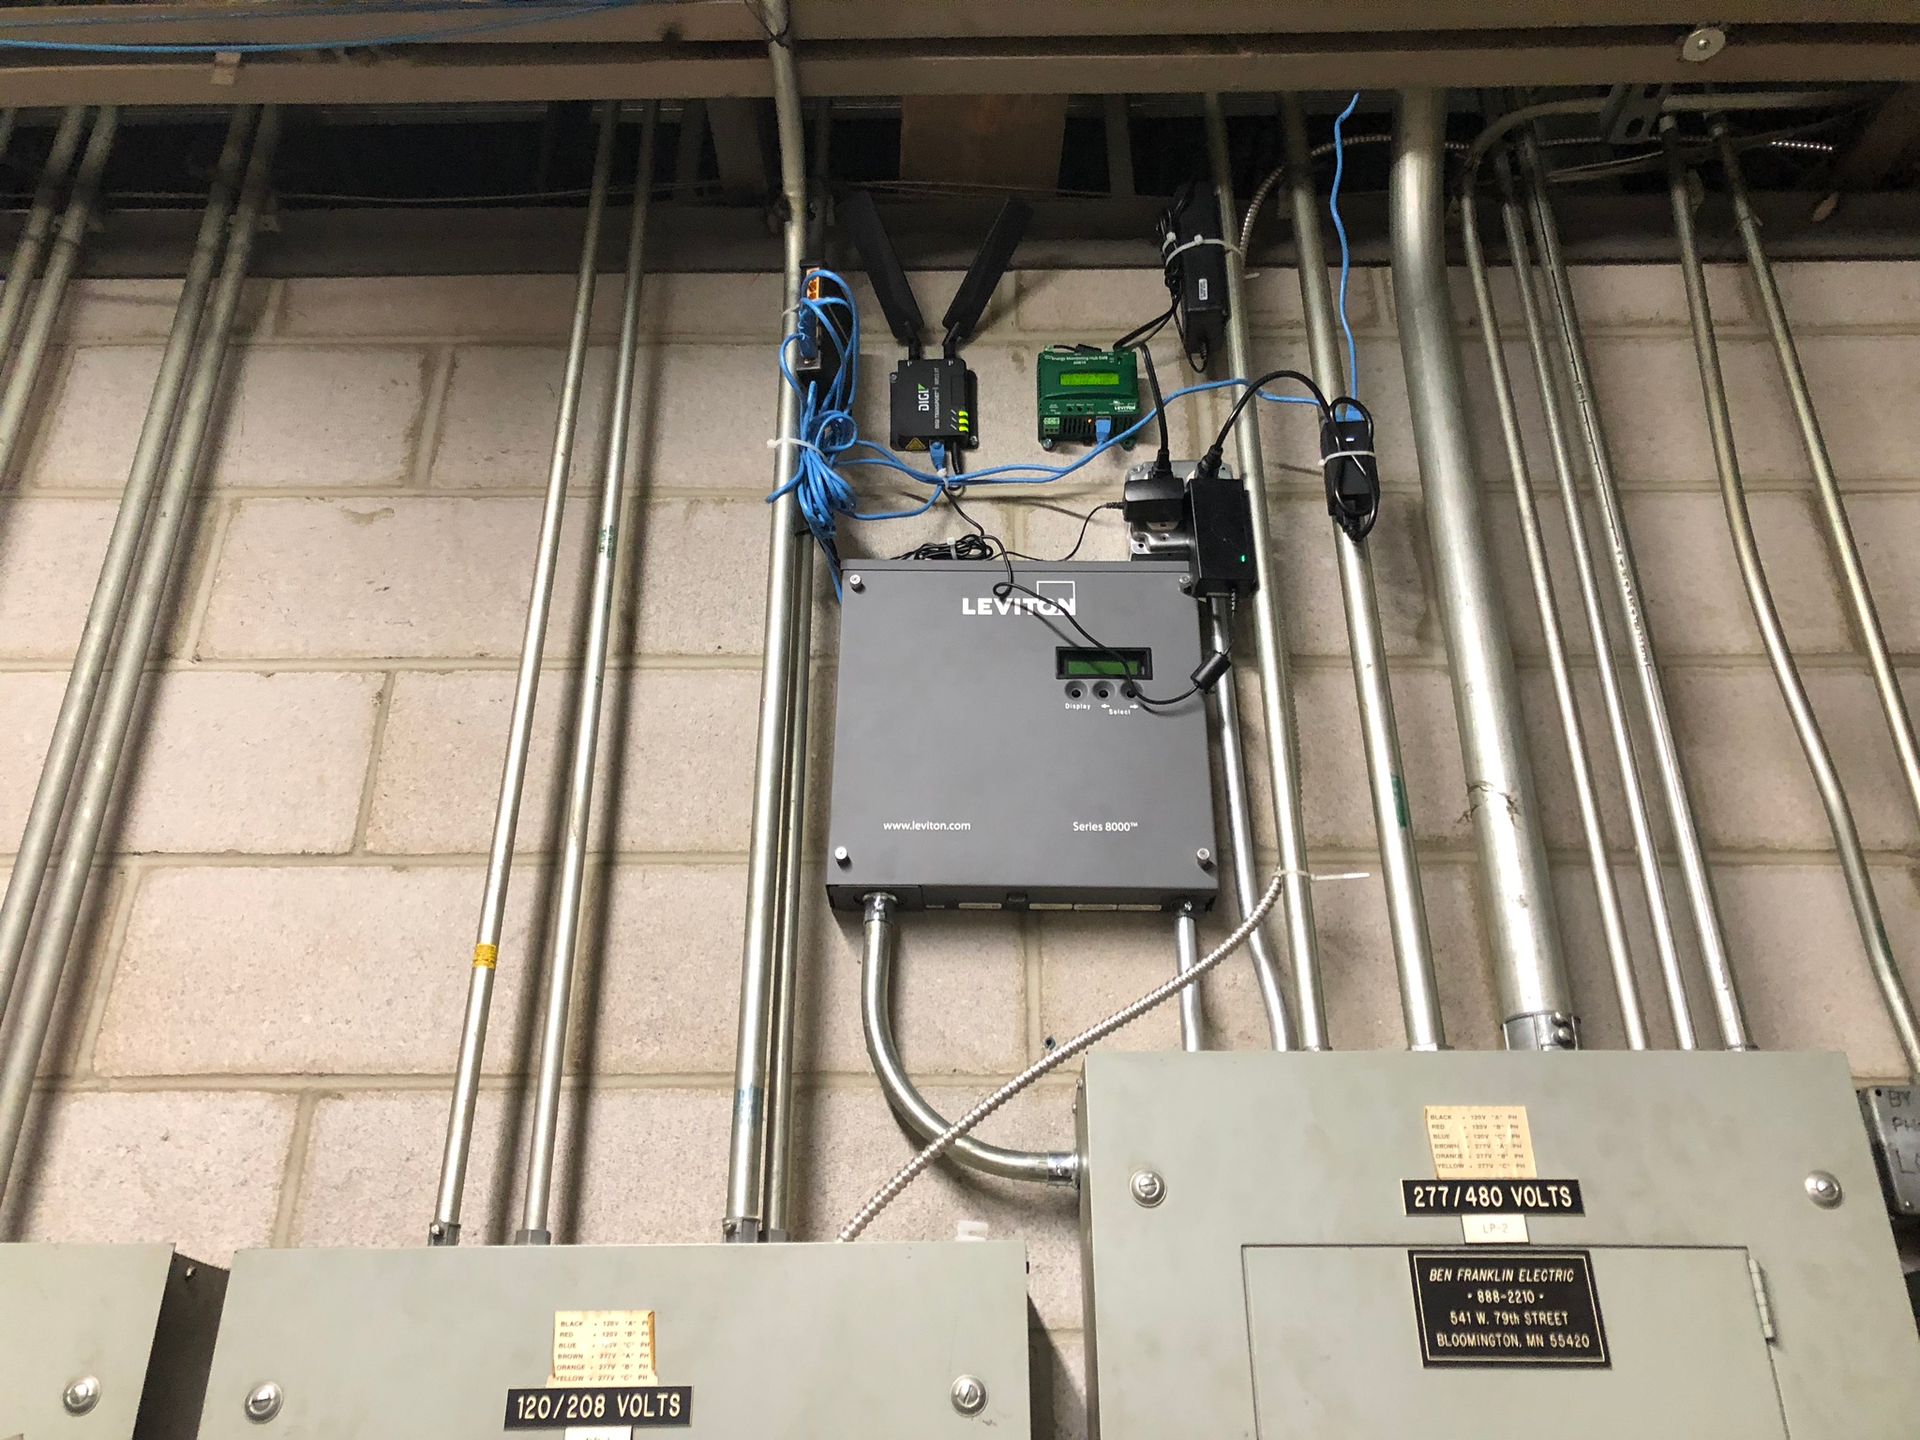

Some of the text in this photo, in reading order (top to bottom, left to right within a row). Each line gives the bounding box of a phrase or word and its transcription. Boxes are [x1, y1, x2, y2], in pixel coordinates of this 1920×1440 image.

[918, 388, 930, 412] DIGI
[962, 597, 1077, 616] LEVITON
[1064, 702, 1092, 711] Display
[1108, 707, 1131, 715] Select
[883, 820, 971, 832] www.leviton.com
[1072, 821, 1103, 832] Series
[1413, 1186, 1573, 1208] 277/480 VOLTS
[1483, 1223, 1509, 1233] LP-2
[1429, 1268, 1575, 1283] BEN FRANKLIN ELECTRIC
[1477, 1289, 1535, 1304] 888-2210
[1450, 1310, 1569, 1326] 541 W. 79th STREET
[1437, 1332, 1590, 1349] BLOOMINGTON, MN 55420
[517, 1392, 681, 1420] 120/208 VOLTS
